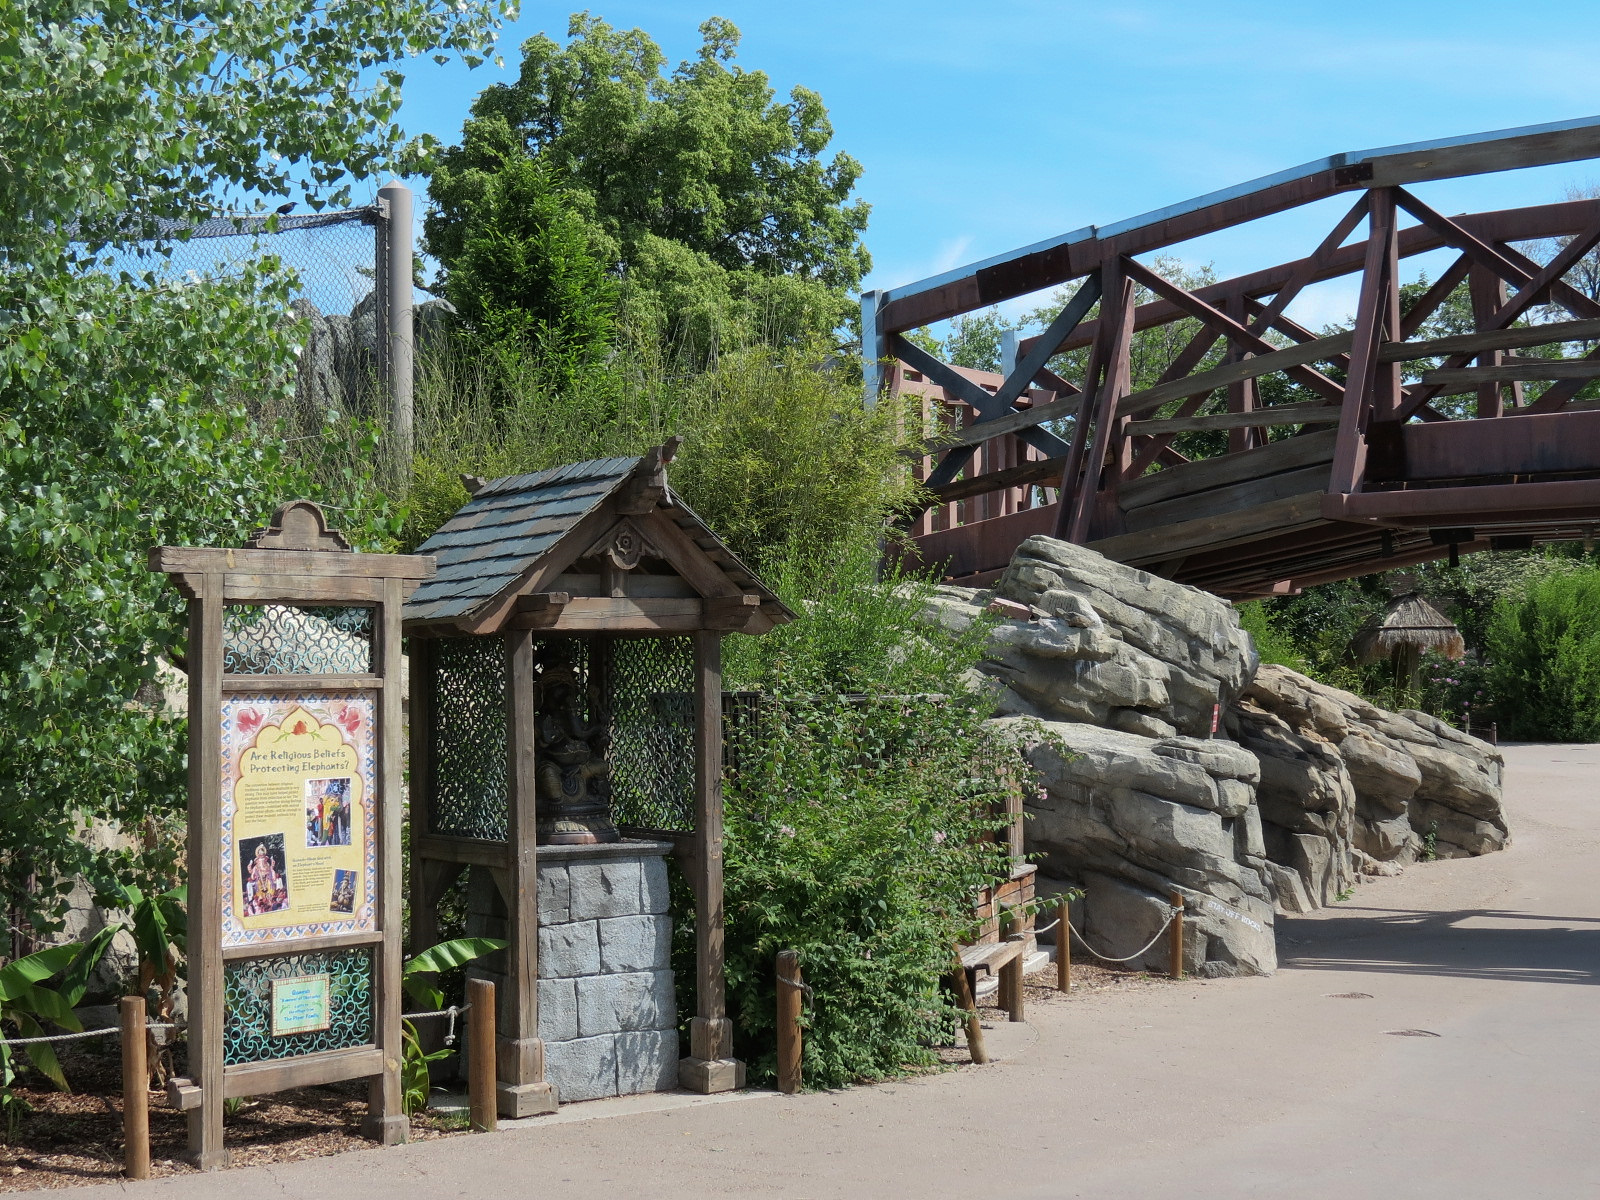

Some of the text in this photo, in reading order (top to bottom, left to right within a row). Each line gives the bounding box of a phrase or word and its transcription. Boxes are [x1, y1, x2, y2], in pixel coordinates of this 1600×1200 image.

[250, 749, 346, 761] Are Religious Beliefs
[250, 760, 350, 774] Protecting Elephants?
[1225, 909, 1241, 920] OFF
[1241, 915, 1261, 932] ROCKS
